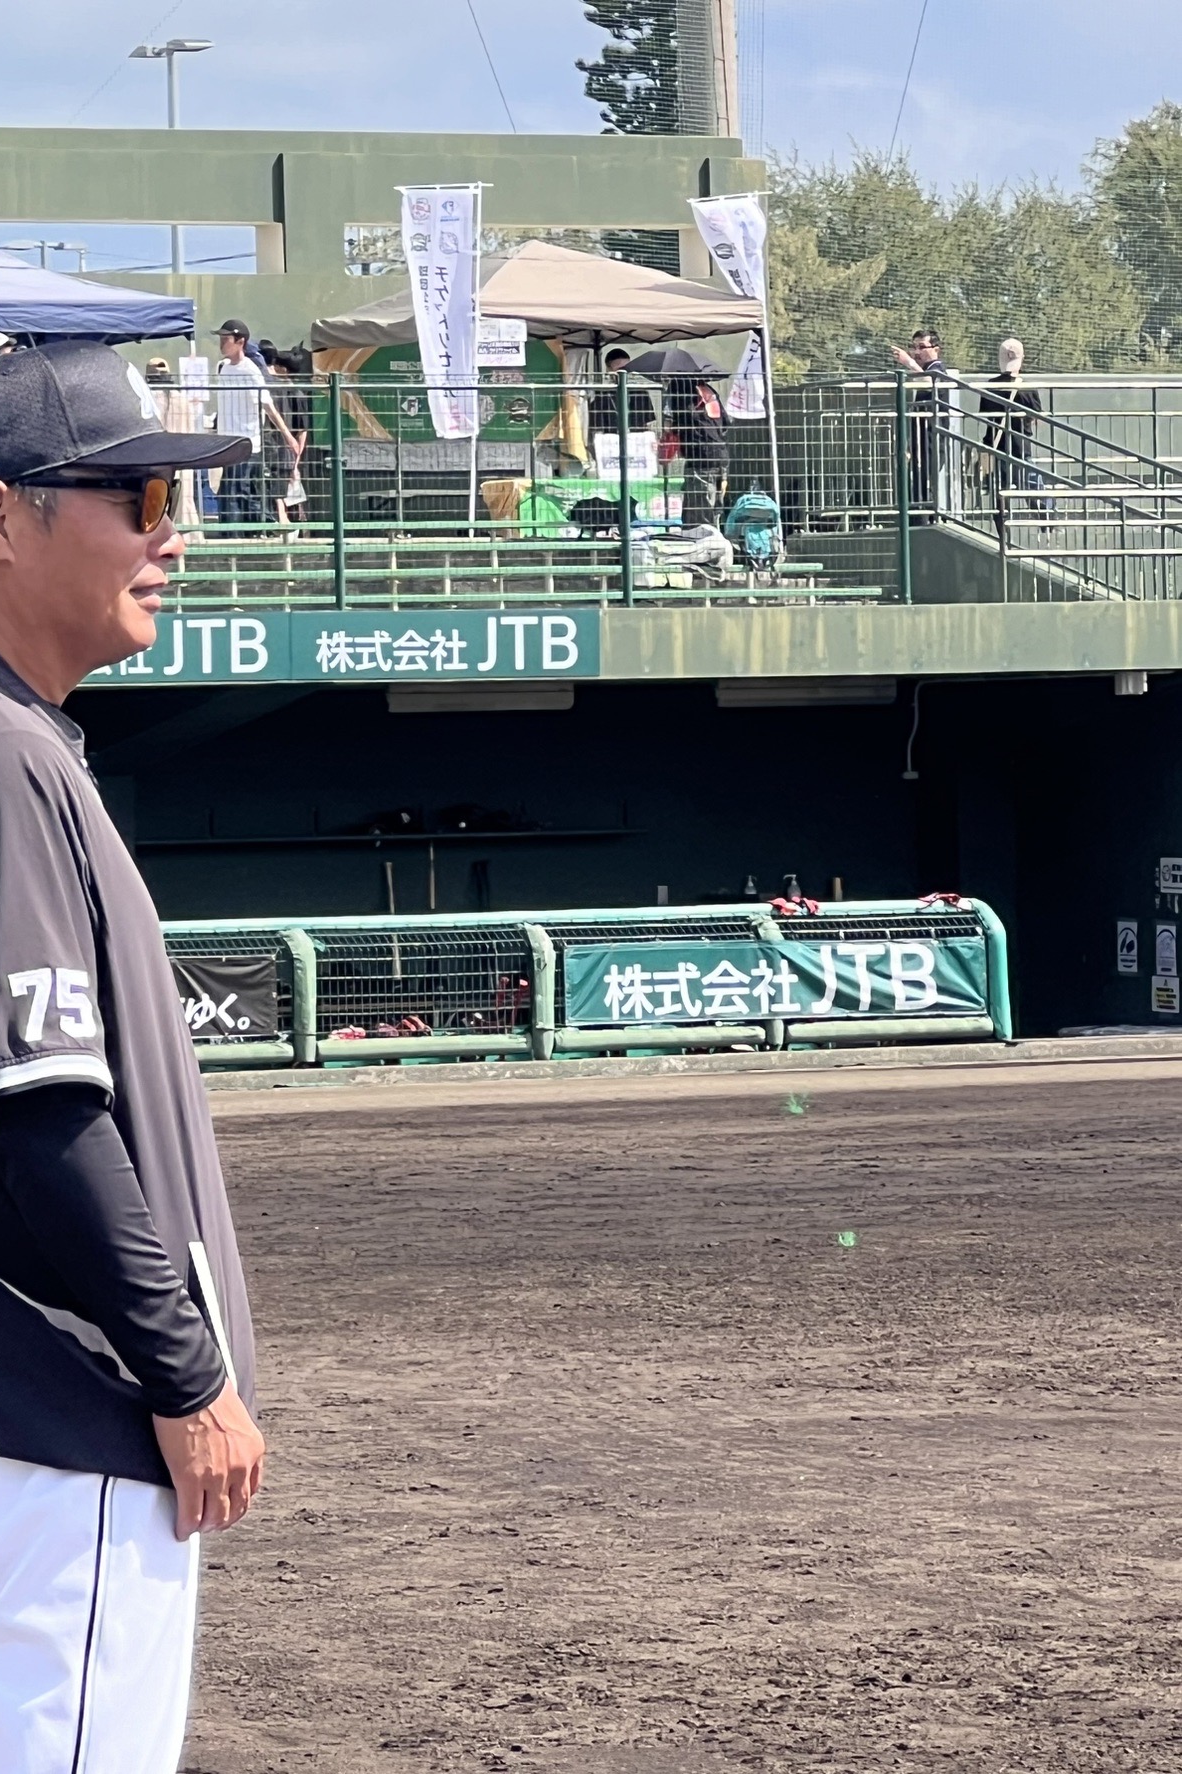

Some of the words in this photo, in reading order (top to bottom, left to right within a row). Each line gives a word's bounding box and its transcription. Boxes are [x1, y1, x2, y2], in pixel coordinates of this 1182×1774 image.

[163, 618, 269, 676] JTB
[315, 629, 468, 672] 株式会社
[477, 615, 579, 671] JTB
[7, 967, 97, 1042] 75
[604, 958, 801, 1021] 株式会社
[811, 943, 938, 1014] JTB
